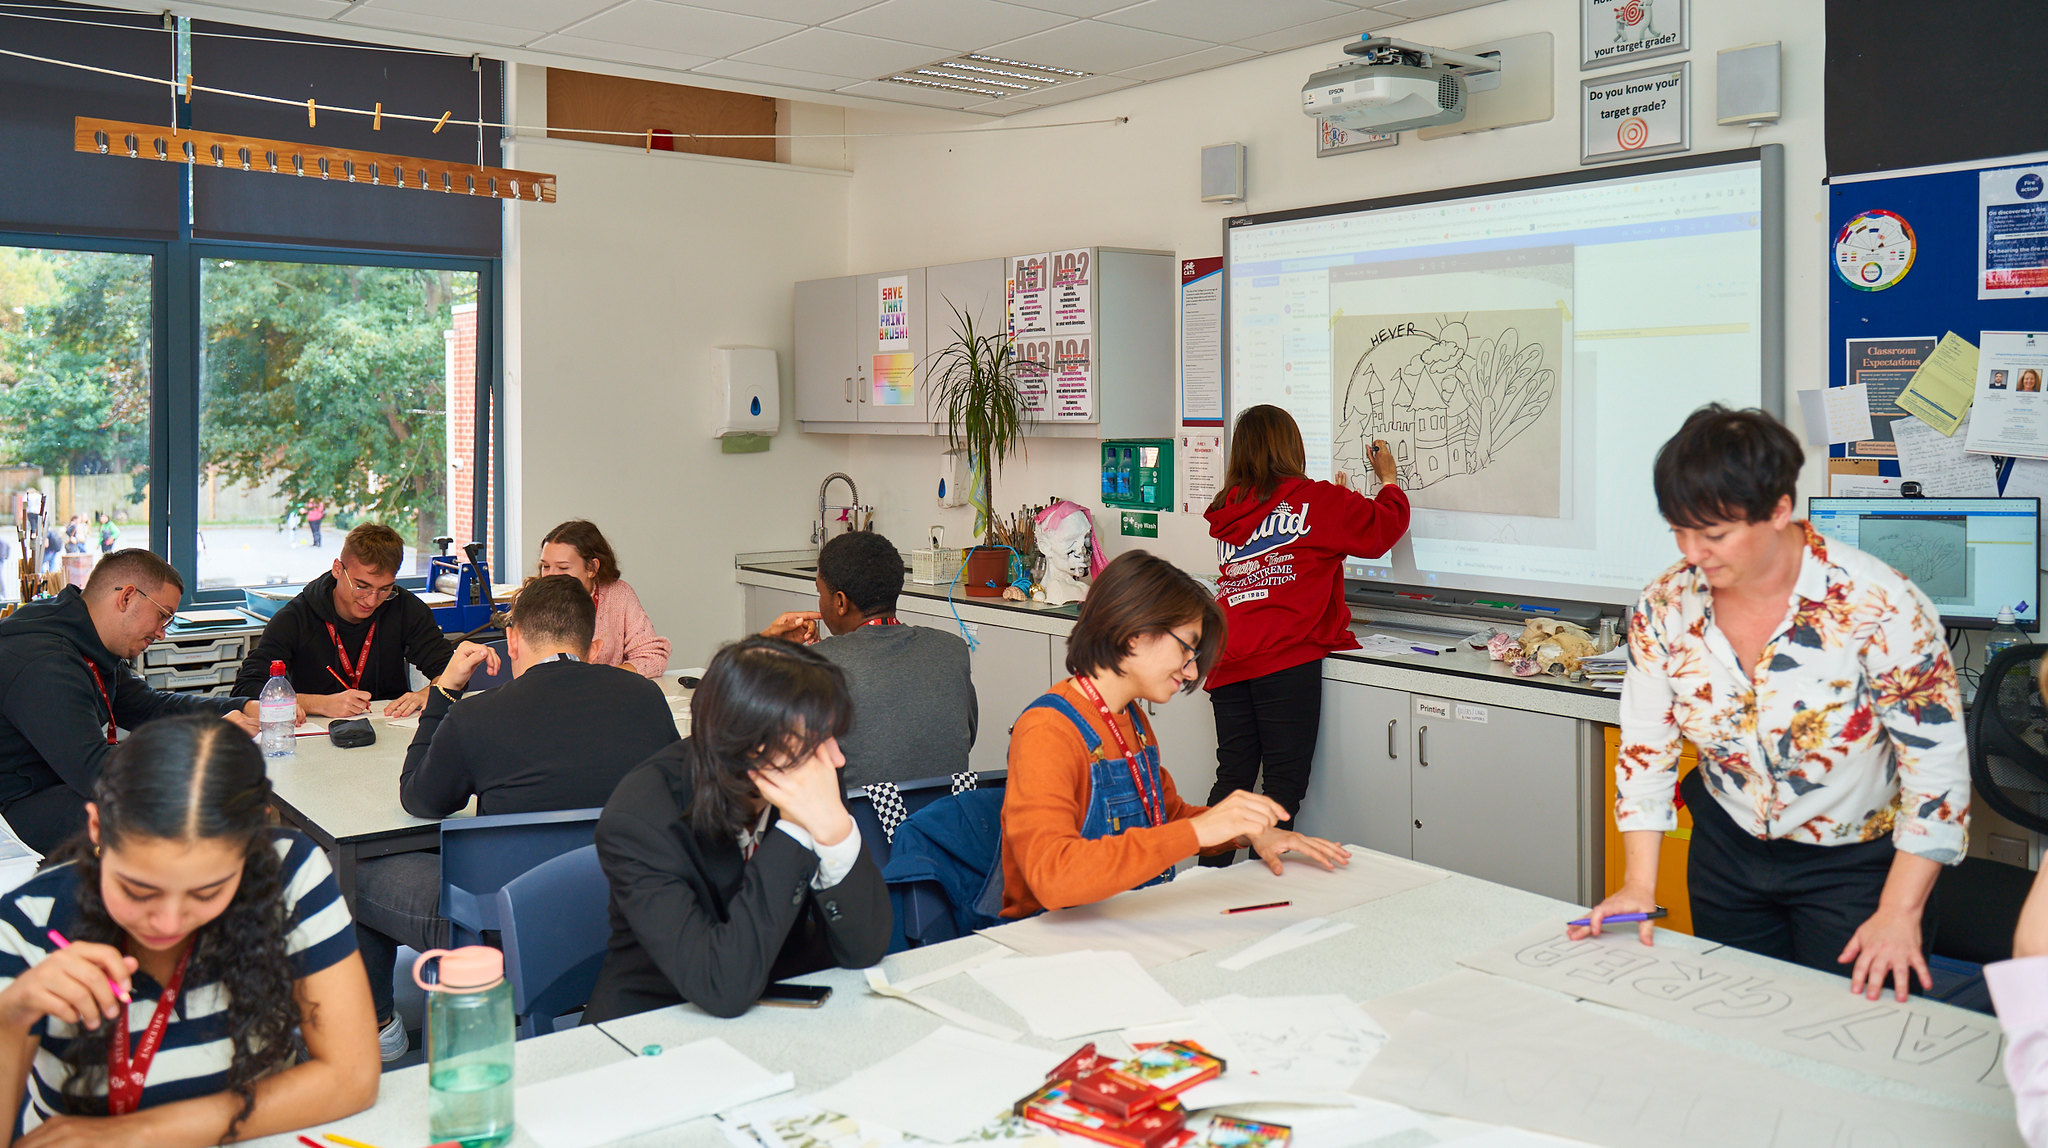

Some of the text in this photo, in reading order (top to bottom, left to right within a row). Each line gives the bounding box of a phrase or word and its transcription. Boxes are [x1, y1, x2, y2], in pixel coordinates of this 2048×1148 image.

[1595, 33, 1676, 58] your target grade?
[1590, 78, 1679, 100] Do you know your
[1601, 100, 1666, 119] target grade?
[1016, 257, 1047, 290] AO1
[1053, 252, 1089, 288] AO2
[883, 286, 902, 300] SAVE
[883, 300, 903, 313] THAT
[880, 313, 905, 326] PAINT
[880, 326, 907, 340] BRUSH!
[1371, 322, 1414, 346] HEVER
[1016, 342, 1050, 375] AO3
[1053, 339, 1090, 373] AO4
[1868, 347, 1916, 355] Classroom
[1863, 358, 1920, 368] Expectations
[1247, 565, 1292, 584] EXTREME
[1081, 677, 1100, 701] STUDENT
[1420, 704, 1445, 716] Printing
[1108, 720, 1124, 744] STUDENT
